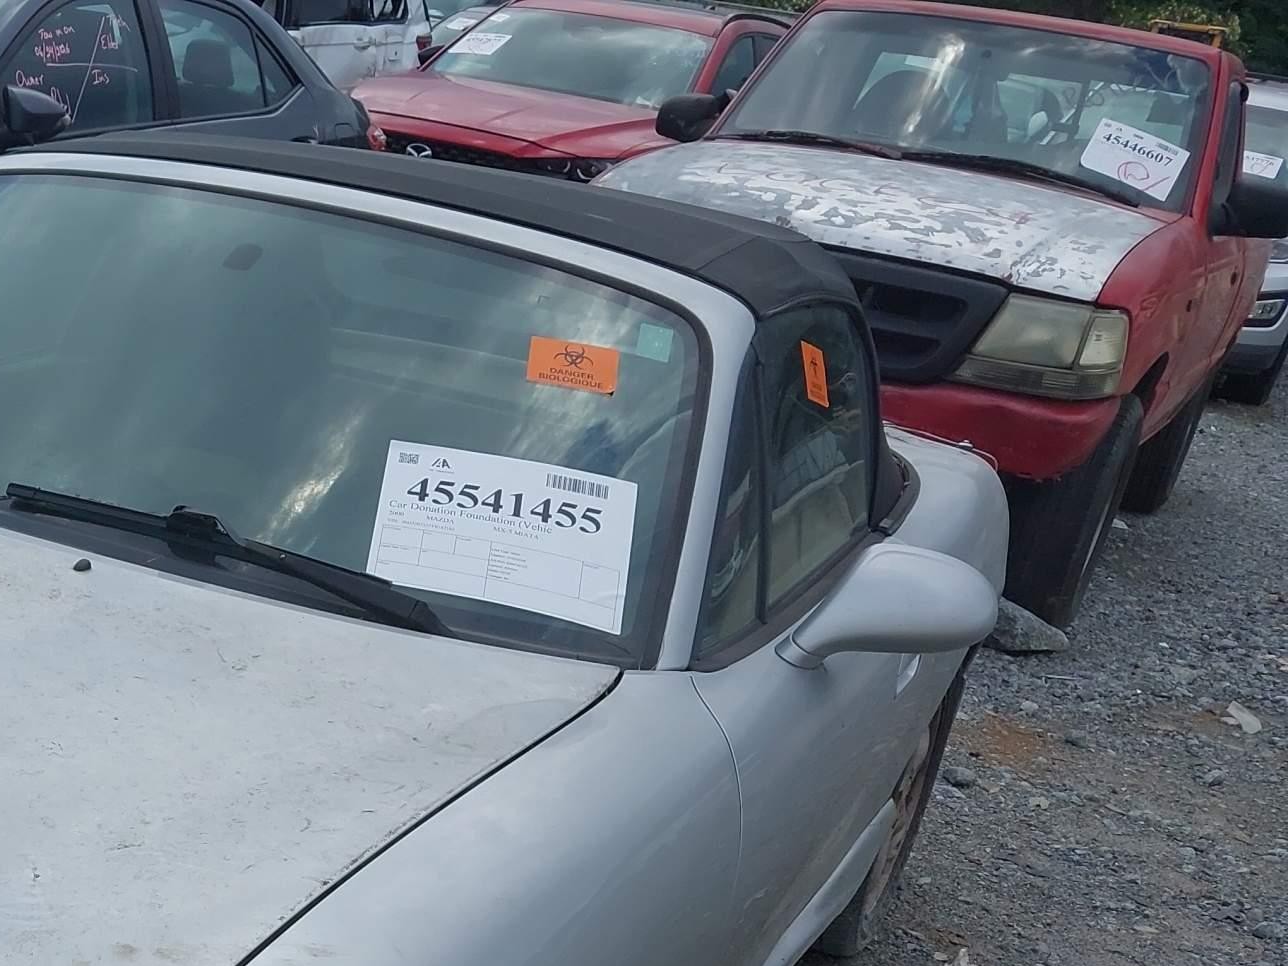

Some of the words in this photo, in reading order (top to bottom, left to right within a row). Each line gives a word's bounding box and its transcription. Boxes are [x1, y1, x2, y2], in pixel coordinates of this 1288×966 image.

[15, 70, 44, 88] Owner
[1102, 133, 1174, 167] 45446607
[538, 372, 604, 389] BIOLOGIQUE
[550, 367, 595, 381] DANGER
[389, 499, 408, 509] Car
[410, 502, 456, 517] Donation
[460, 509, 516, 527] Foundation
[406, 477, 603, 534] 45541455
[426, 515, 455, 525] MAZDA
